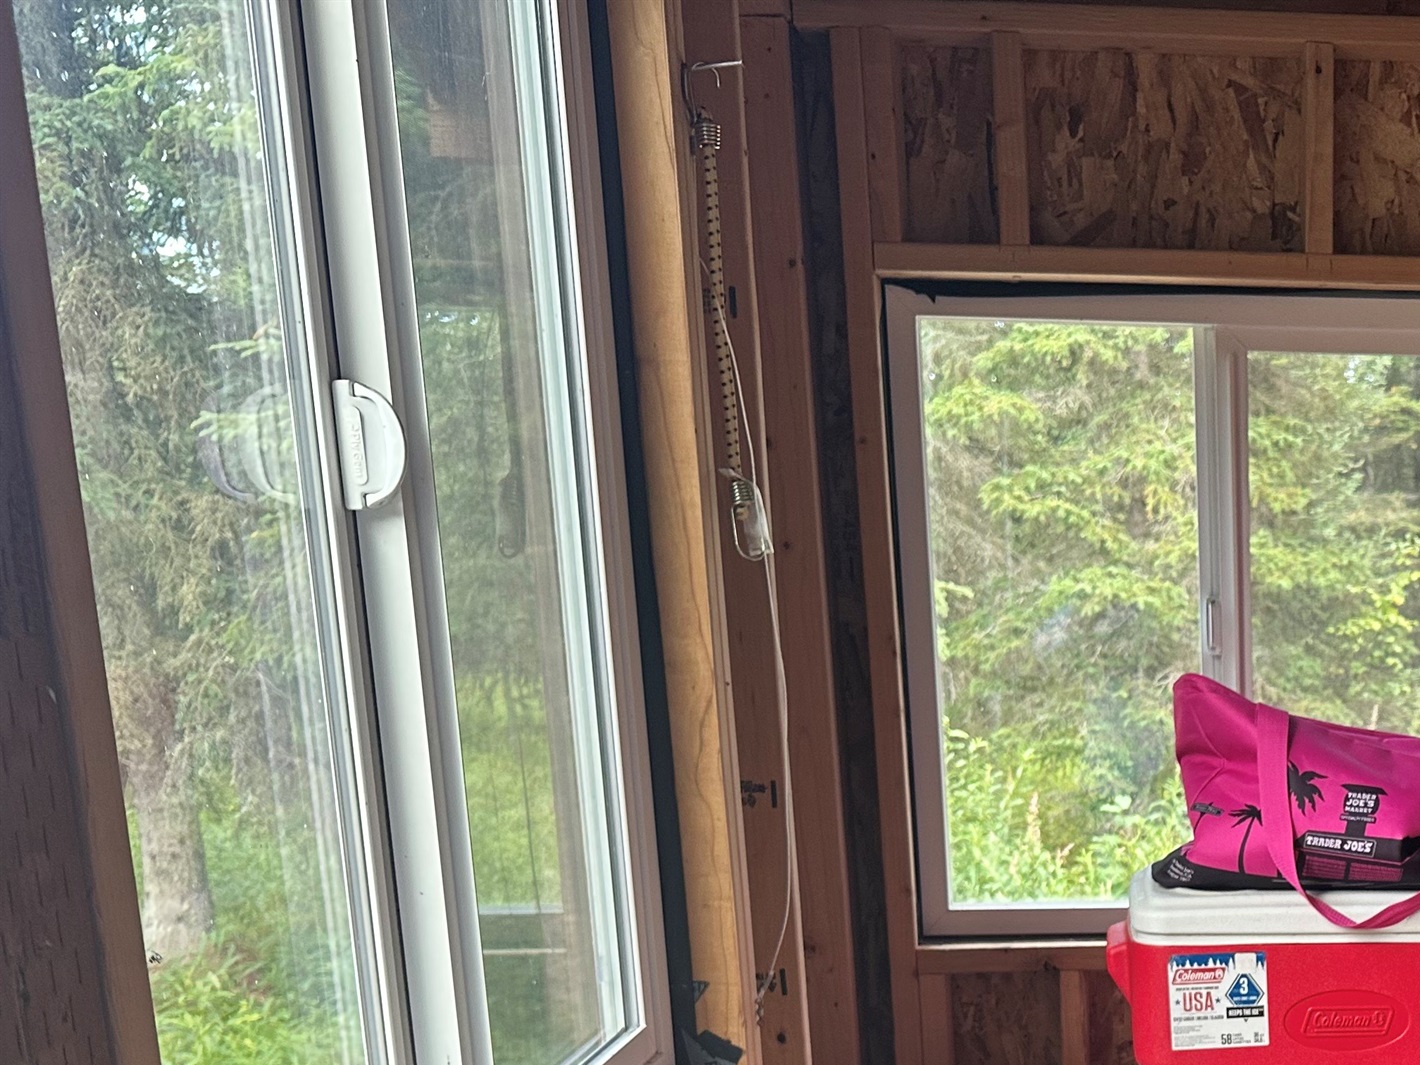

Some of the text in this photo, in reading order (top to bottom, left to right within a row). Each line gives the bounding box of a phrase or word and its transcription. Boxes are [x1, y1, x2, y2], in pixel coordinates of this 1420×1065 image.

[1345, 798, 1375, 808] JOE'S
[1347, 791, 1377, 801] TRADER
[1305, 835, 1373, 853] TRADER JOE'S
[1175, 968, 1214, 981] Coleman
[1239, 977, 1249, 995] 3
[1182, 990, 1215, 1013] USA
[1313, 1011, 1369, 1027] Coleman
[1220, 1033, 1233, 1045] 58
